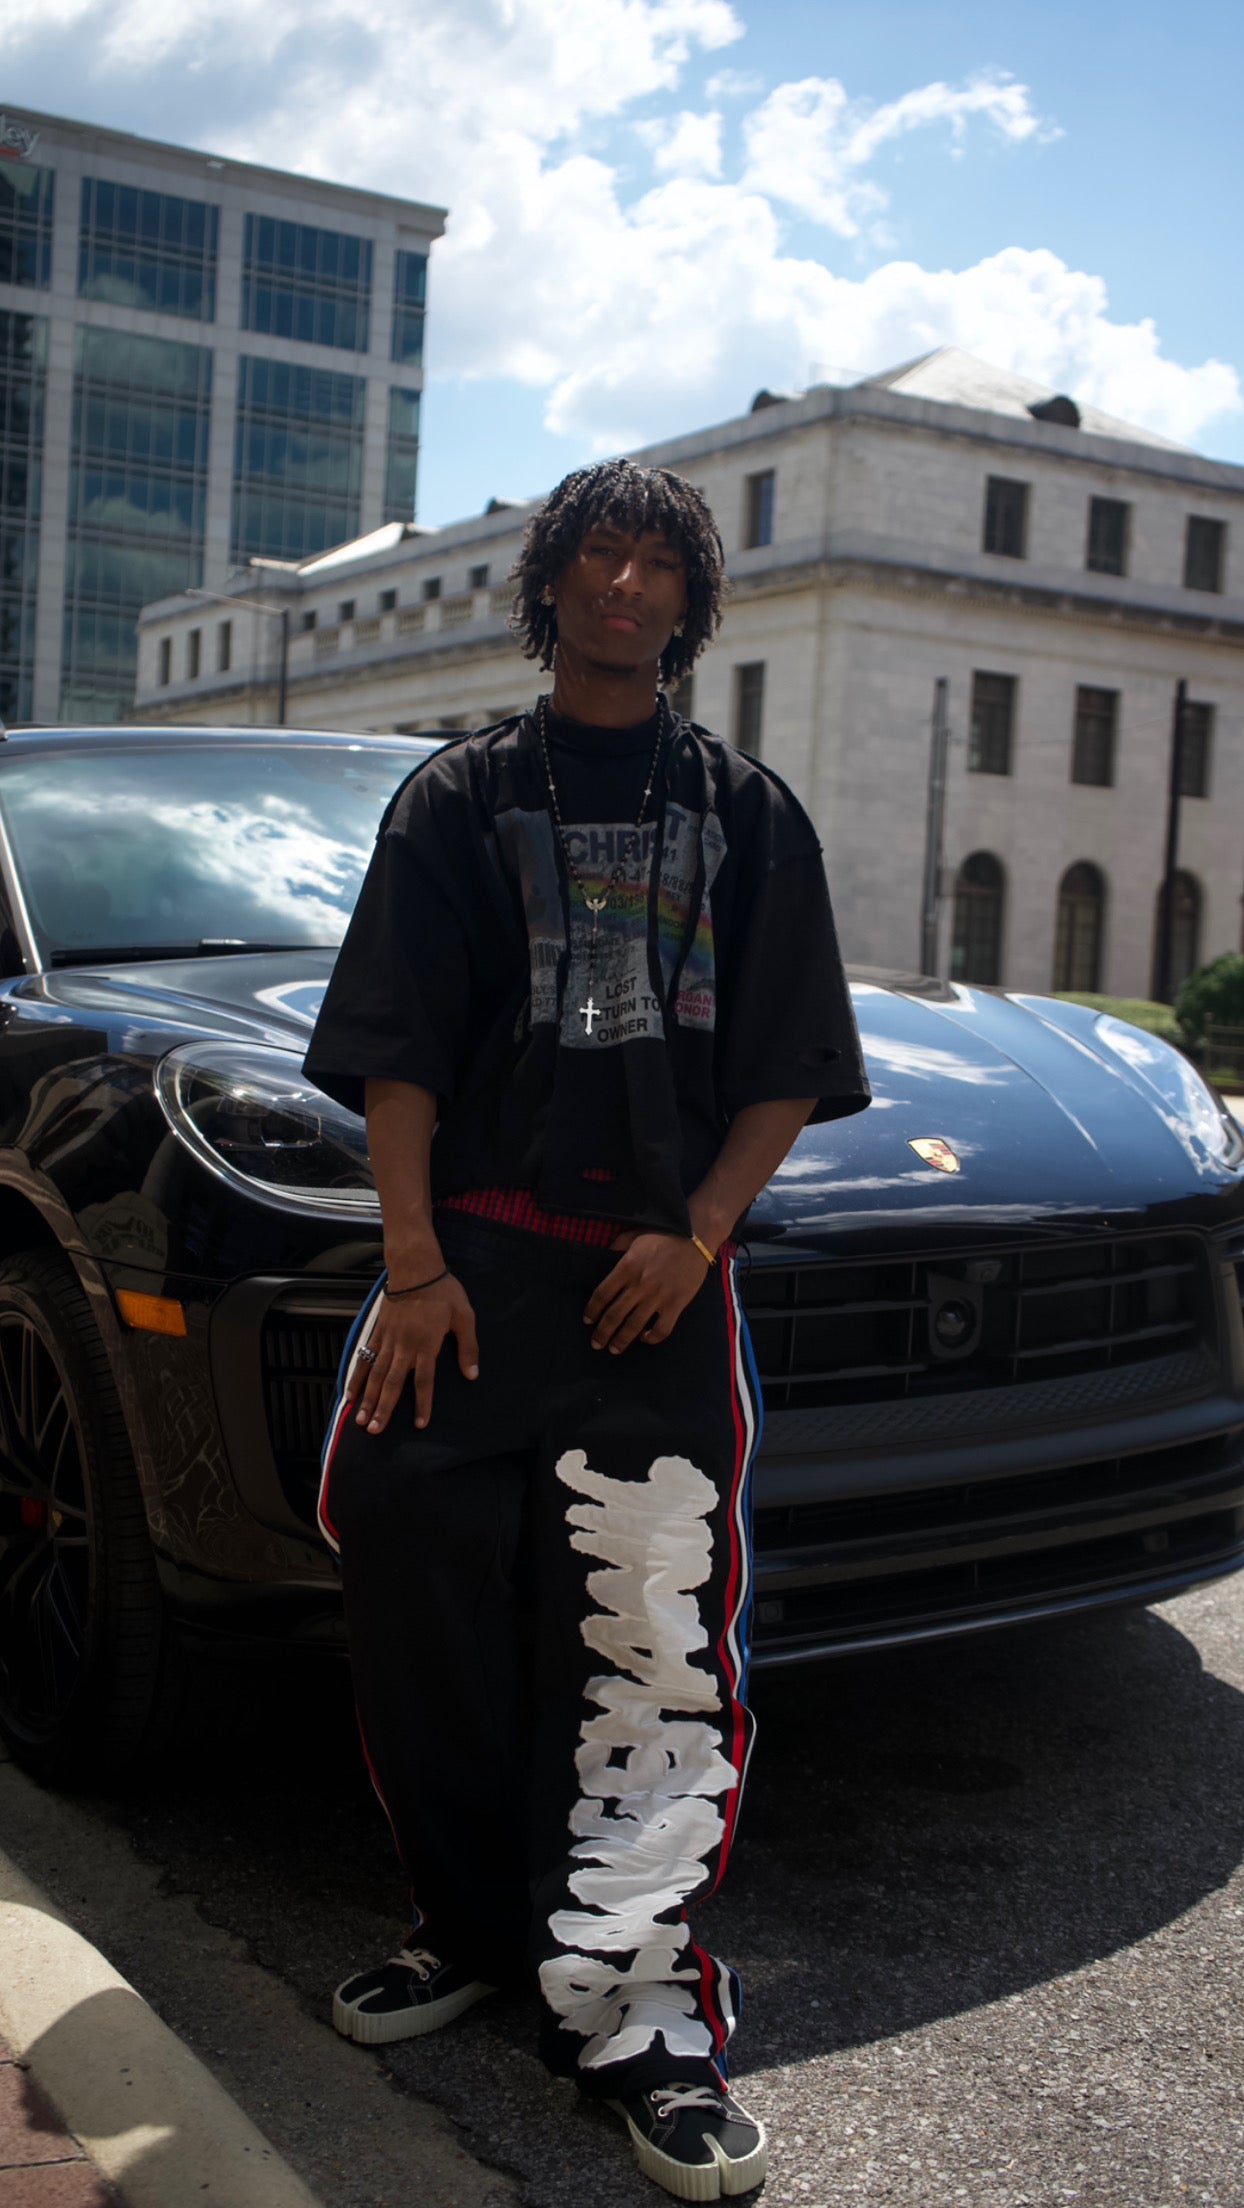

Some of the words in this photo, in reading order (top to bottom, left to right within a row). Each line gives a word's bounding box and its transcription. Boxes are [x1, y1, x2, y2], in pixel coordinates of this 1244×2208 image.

[606, 976, 637, 999] LOST
[641, 996, 663, 1012] TO
[677, 990, 712, 1006] RGAN
[674, 1002, 710, 1019] ONOR
[597, 1017, 649, 1043] OWNER
